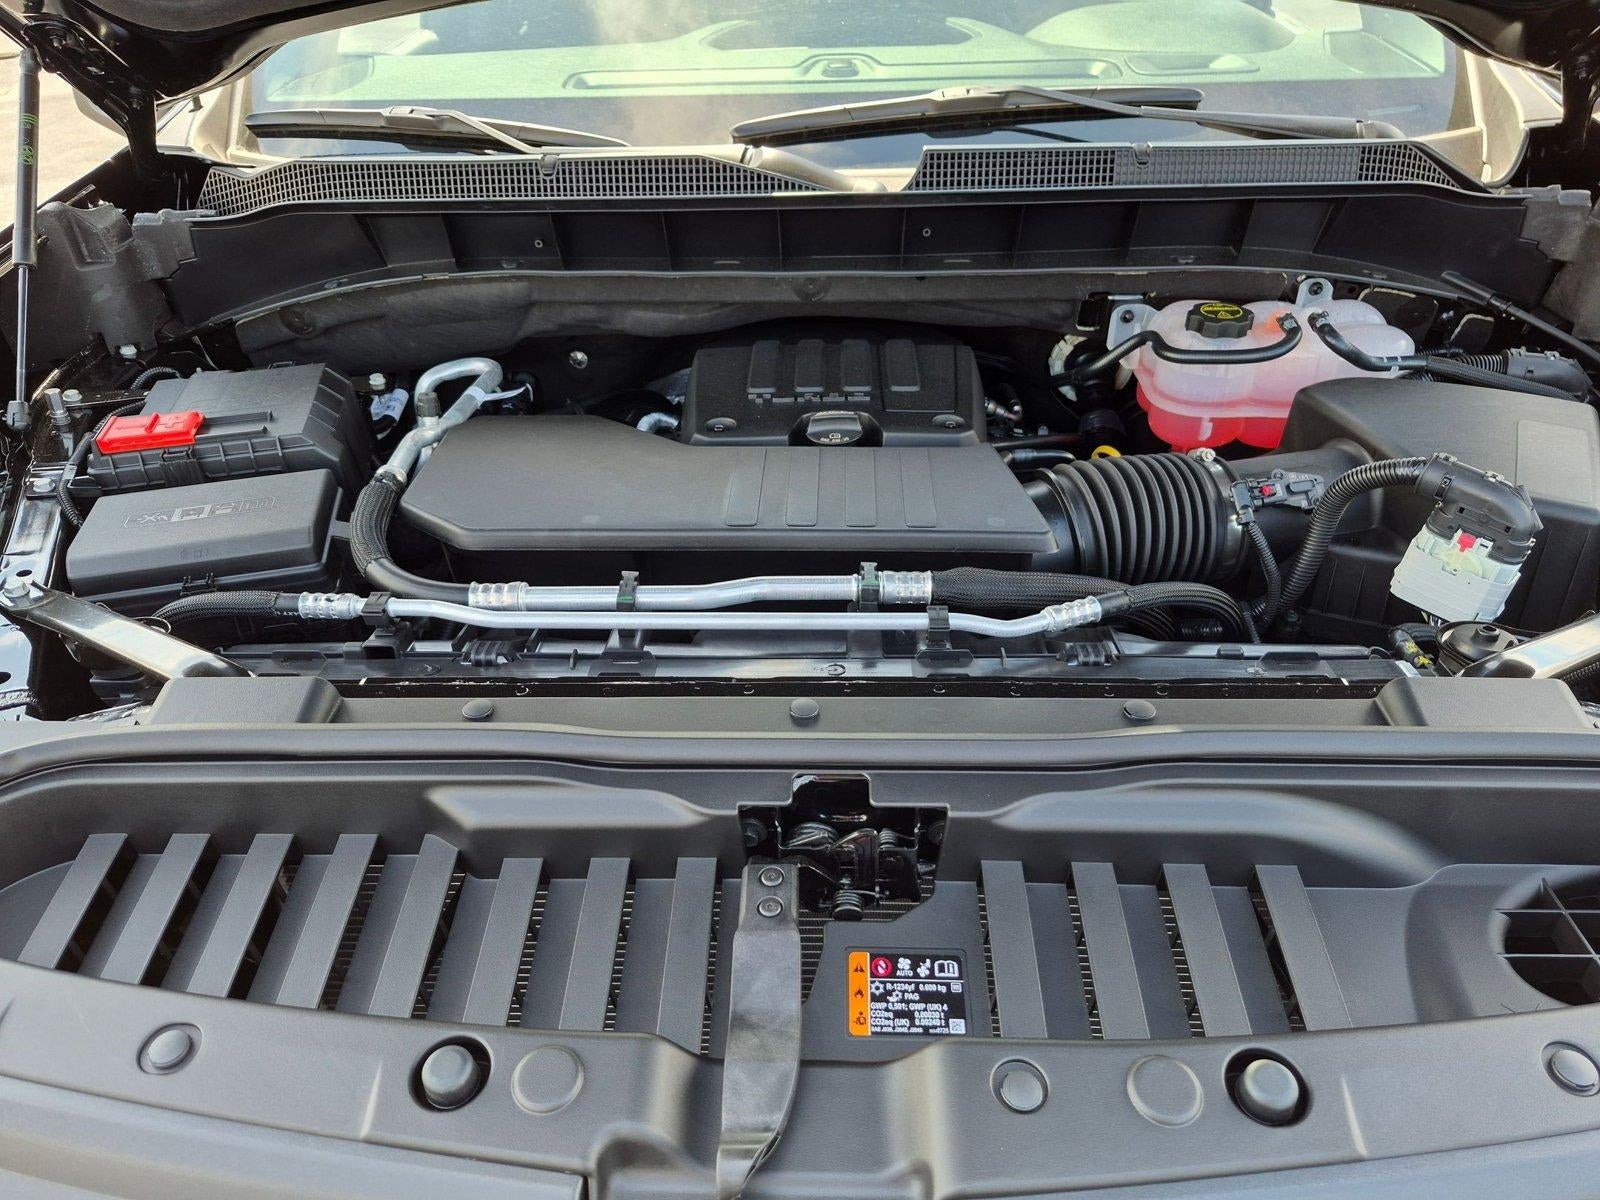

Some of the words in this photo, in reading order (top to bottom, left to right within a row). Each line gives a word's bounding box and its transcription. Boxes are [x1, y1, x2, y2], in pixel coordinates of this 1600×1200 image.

[886, 983, 915, 992] R-1234yf
[937, 984, 947, 993] kg
[870, 1002, 887, 1010] GWP
[927, 1003, 942, 1012] (UK)
[870, 1010, 894, 1019] CO2eq
[870, 1018, 894, 1027] CO2eq
[894, 1018, 910, 1027] (UK)
